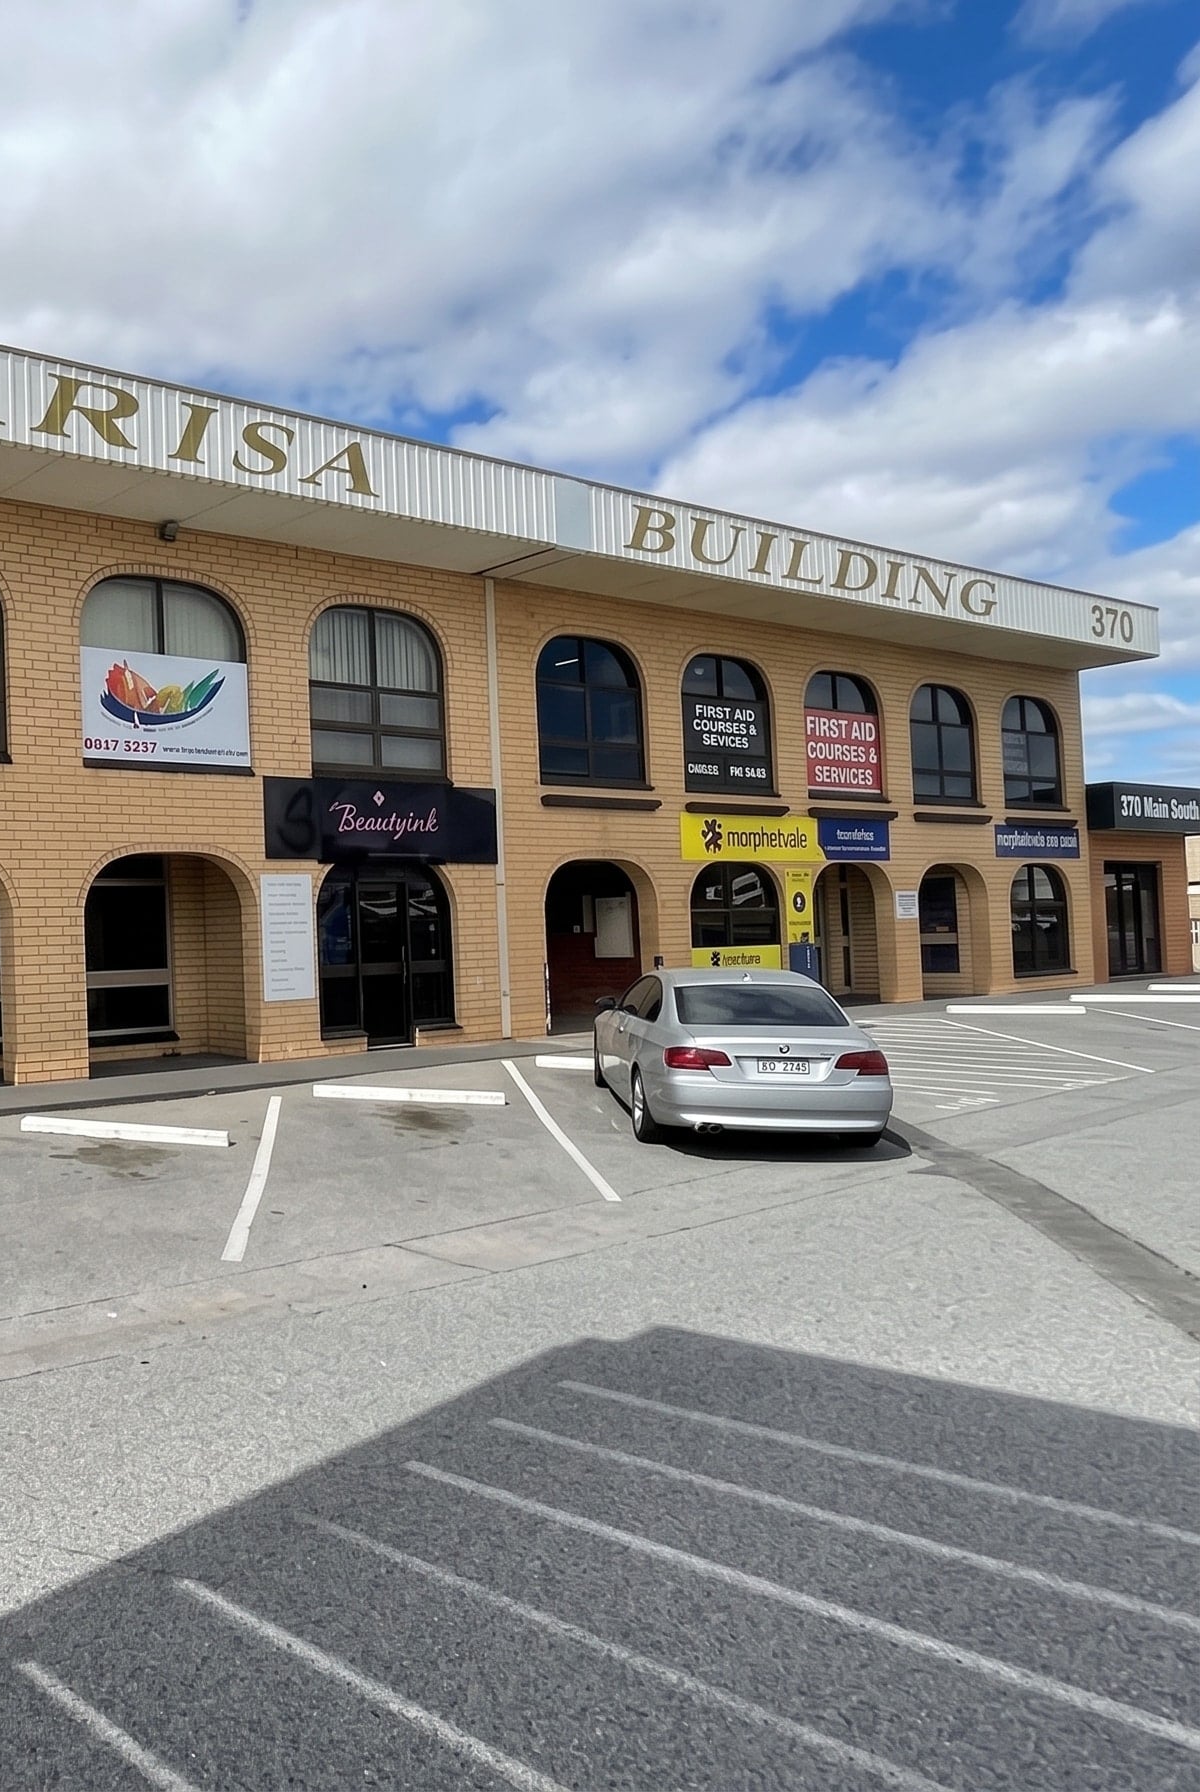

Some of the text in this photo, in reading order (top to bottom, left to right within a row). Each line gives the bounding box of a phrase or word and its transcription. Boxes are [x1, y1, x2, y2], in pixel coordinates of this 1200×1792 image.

[623, 504, 998, 616] BUILDING
[1091, 604, 1134, 644] 370
[695, 704, 755, 722] FIRST AID
[693, 718, 757, 736] COURSES &
[806, 716, 876, 742] FIRST AID
[84, 737, 120, 751] 0817
[702, 733, 749, 749] SEVICES
[807, 741, 877, 764] COURSES &
[815, 765, 873, 786] SERVICES
[1120, 794, 1200, 821] 370 Main South
[329, 801, 439, 840] Beautyink
